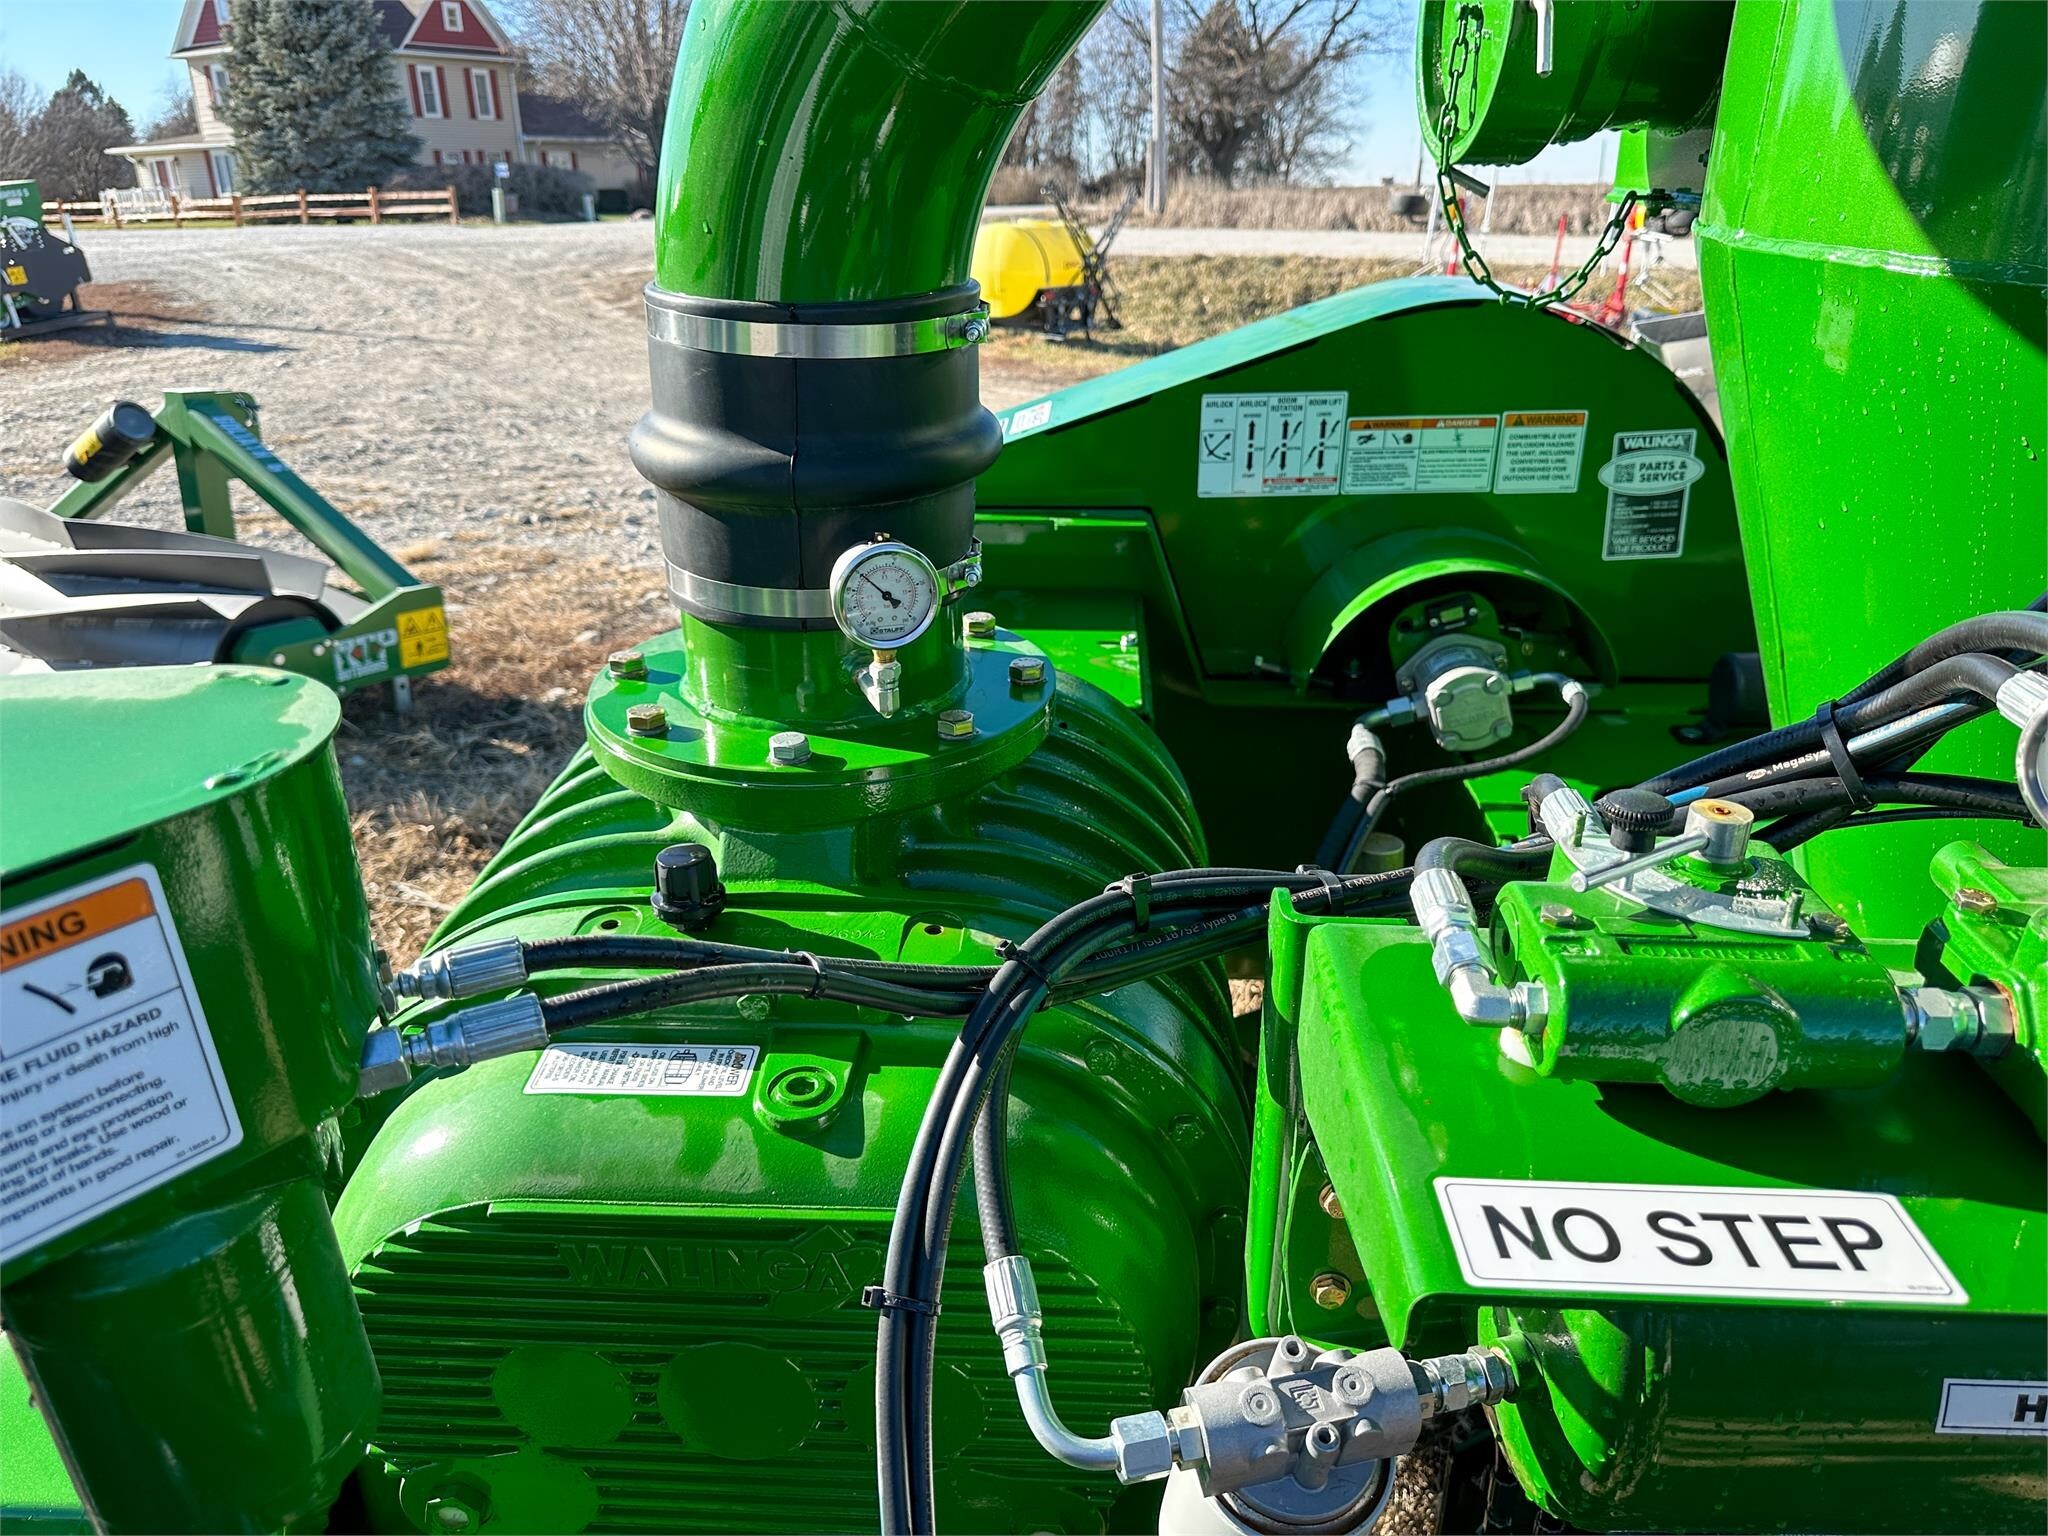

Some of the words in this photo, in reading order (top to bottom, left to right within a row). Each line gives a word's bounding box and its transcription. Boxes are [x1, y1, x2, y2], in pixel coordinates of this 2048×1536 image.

[1239, 400, 1267, 408] AIRLOCK
[1445, 419, 1480, 427] DANGER
[1526, 415, 1577, 425] WARNING
[1623, 435, 1685, 450] WALINGA
[1639, 461, 1674, 471] PARTS
[1678, 460, 1688, 470] &
[1639, 472, 1686, 483] SERVICE
[1611, 535, 1639, 545] VALUE
[1639, 534, 1676, 543] BEYOND
[1613, 544, 1631, 553] THE
[1631, 543, 1672, 552] PRODUCT
[1354, 870, 1389, 887] MSHA
[24, 1041, 81, 1075] FLUID
[84, 1007, 162, 1048] HAZARD
[46, 1072, 62, 1085] or
[65, 1051, 109, 1077] death
[110, 1035, 147, 1057] from
[146, 1020, 180, 1042] high
[725, 1051, 747, 1086] BLOWER
[17, 1119, 38, 1134] on
[40, 1092, 96, 1123] system
[96, 1070, 145, 1097] before
[41, 1124, 57, 1138] or
[60, 1077, 167, 1129] disconnecting.
[27, 1163, 49, 1178] for
[97, 1126, 129, 1145] Use
[129, 1103, 171, 1130] wood
[172, 1097, 188, 1111] or
[39, 1137, 69, 1159] and
[71, 1126, 99, 1143] eye
[100, 1090, 175, 1133] protection
[51, 1166, 67, 1182] of
[78, 1176, 94, 1189] in
[96, 1154, 134, 1183] good
[134, 1135, 181, 1161] repair.
[1480, 1204, 1622, 1264] NO
[1646, 1210, 1884, 1272] STEP
[559, 1243, 854, 1293] WALINGA
